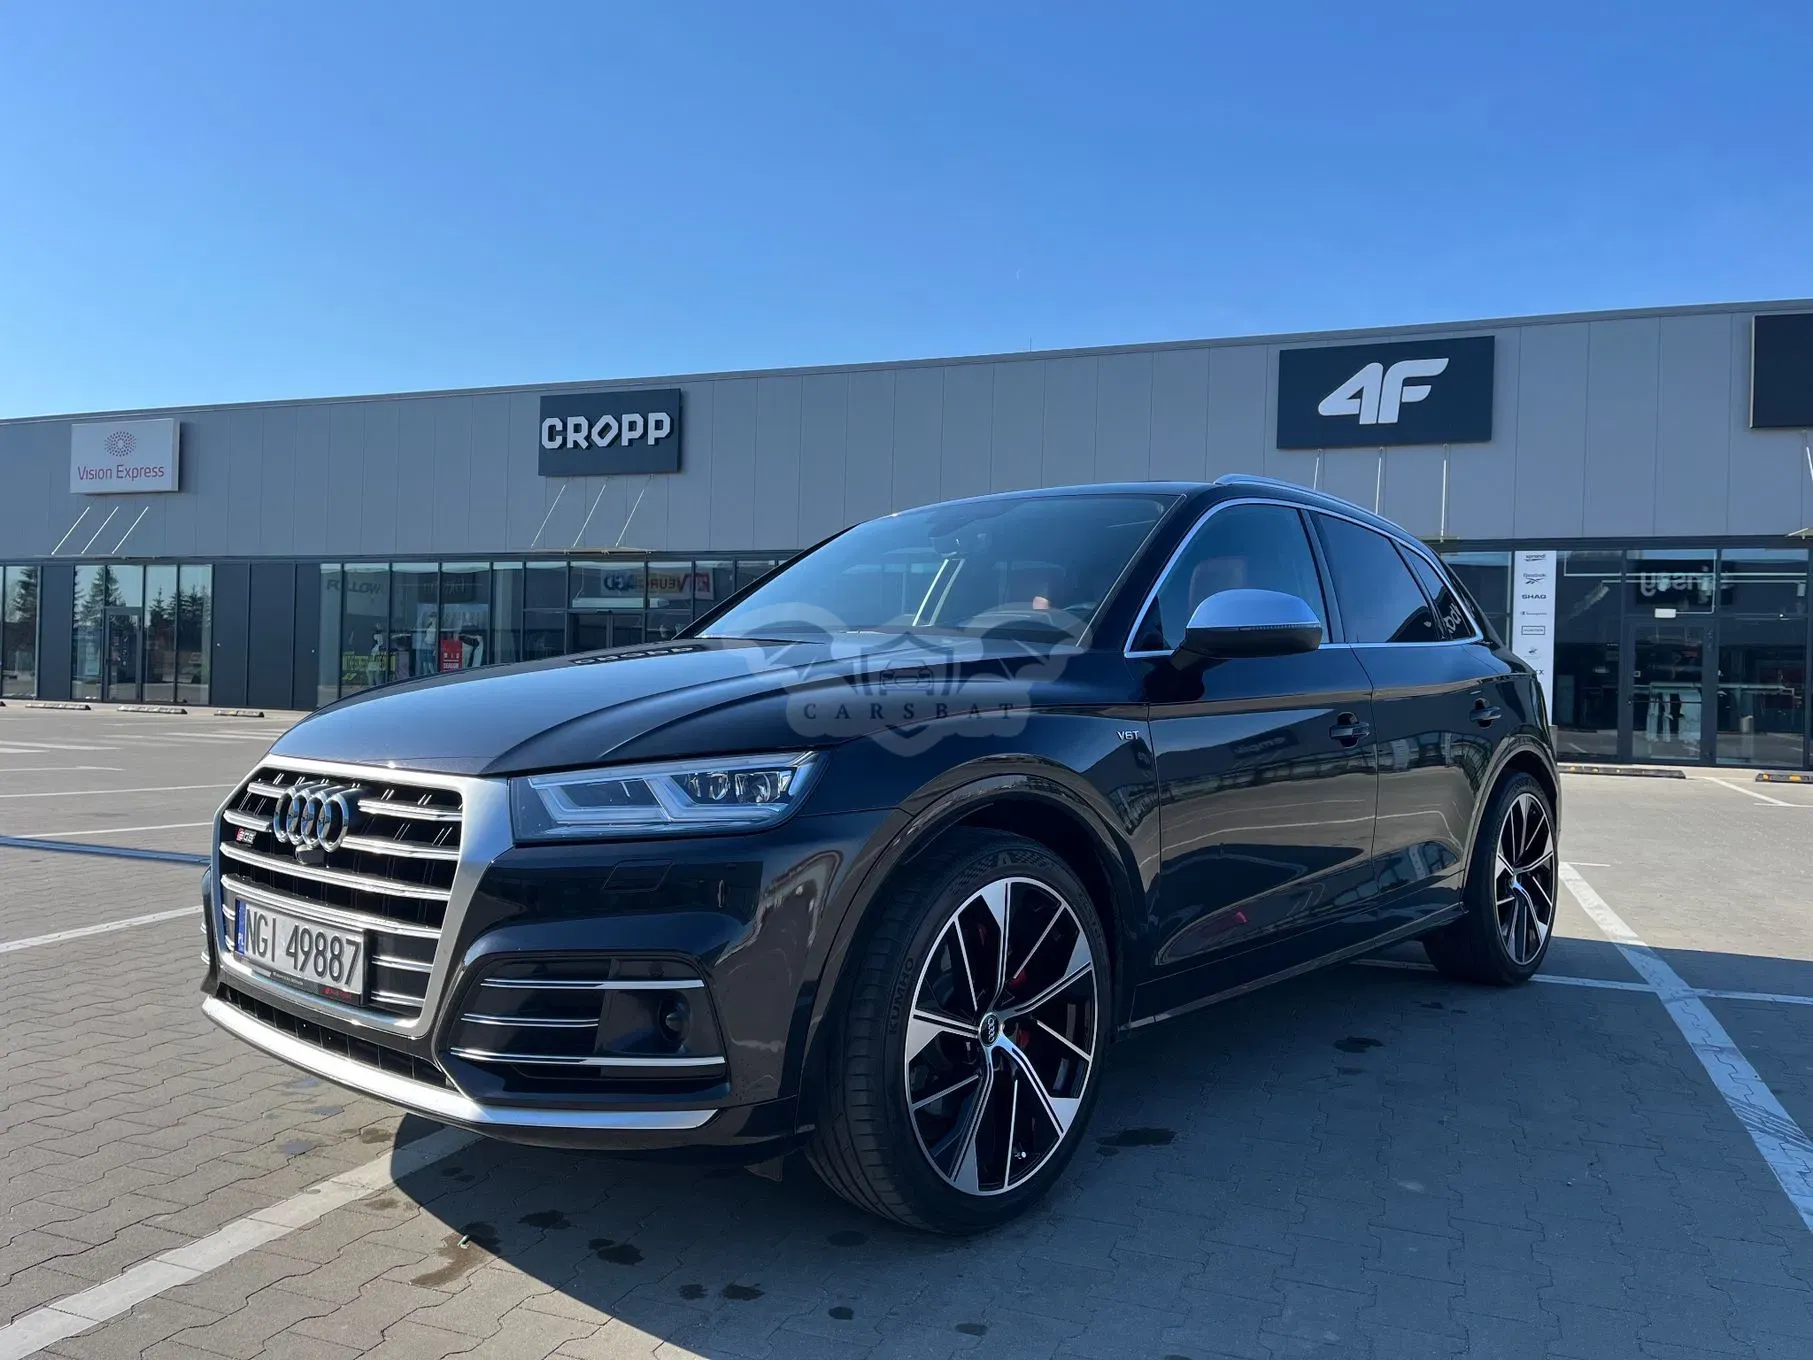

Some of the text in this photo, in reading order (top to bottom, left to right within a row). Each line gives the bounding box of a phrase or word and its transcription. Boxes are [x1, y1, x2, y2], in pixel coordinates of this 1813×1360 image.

[1318, 357, 1450, 425] 4F
[541, 412, 671, 450] CROPP
[77, 464, 165, 482] Vision Express
[1116, 730, 1139, 741] V6T
[246, 908, 361, 987] NGI 49887
